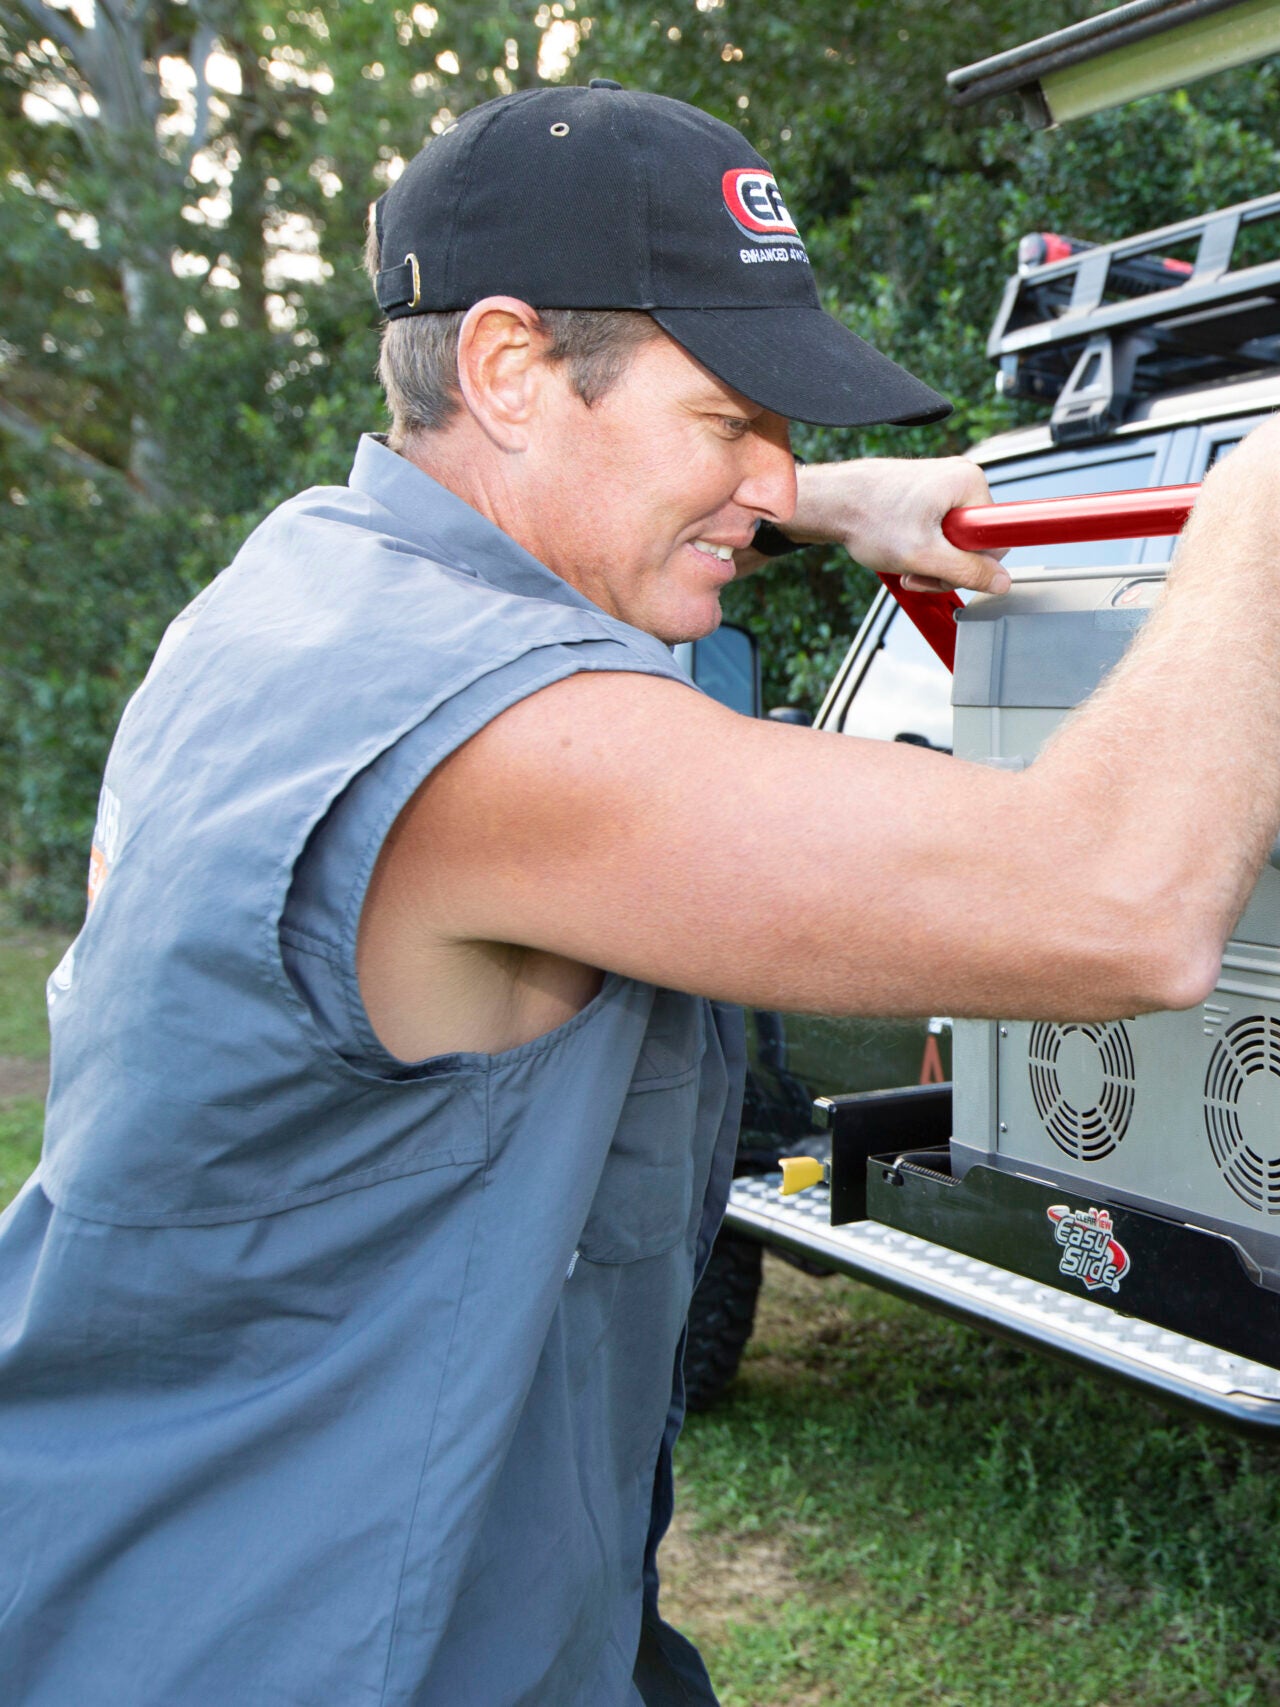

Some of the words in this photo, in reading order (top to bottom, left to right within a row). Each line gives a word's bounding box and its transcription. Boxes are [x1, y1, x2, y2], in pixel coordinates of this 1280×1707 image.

[740, 247, 789, 264] ENHANCED
[1056, 1216, 1111, 1259] Easy
[1061, 1246, 1117, 1284] Slide
